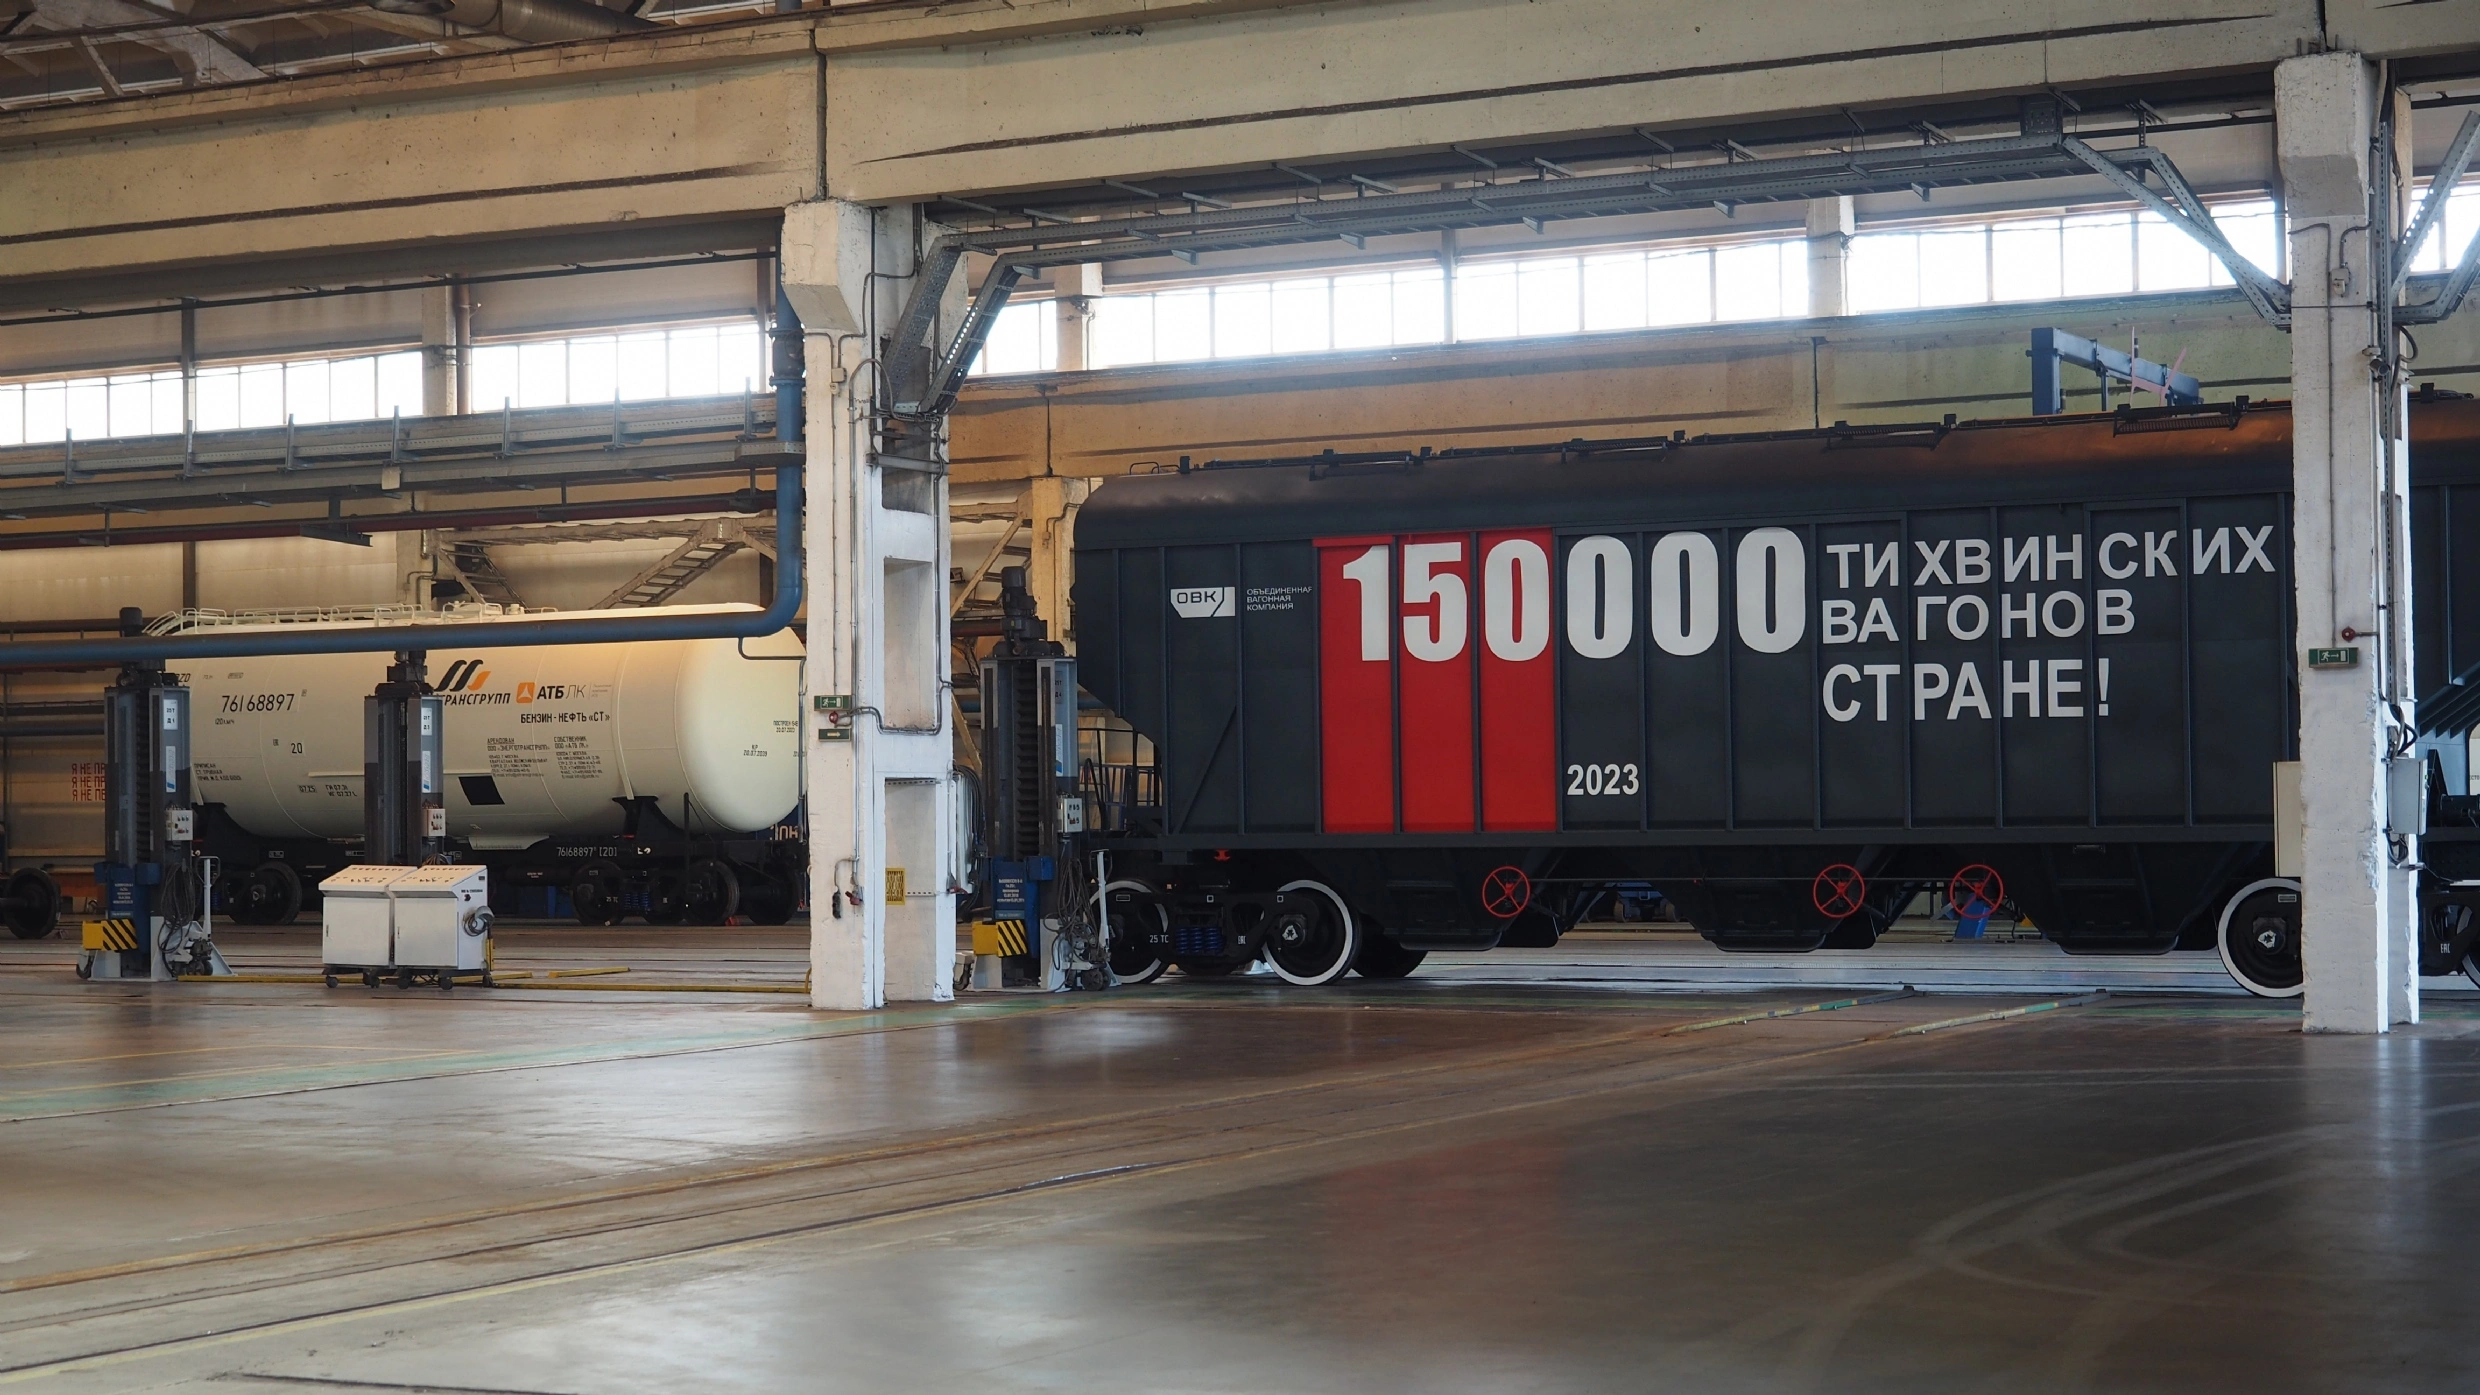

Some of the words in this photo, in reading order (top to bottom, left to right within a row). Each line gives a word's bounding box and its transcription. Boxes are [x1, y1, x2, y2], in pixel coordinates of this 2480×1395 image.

[1826, 526, 2275, 589] ТИХВИНСКИХ
[1177, 591, 1217, 604] ОВК
[1246, 595, 1291, 604] ВАГОННАЯ
[1342, 528, 1806, 662] 150000
[1246, 603, 1294, 611] КОМПАНИЯ
[1822, 589, 2135, 644] ВАГОНОВ
[536, 685, 565, 699] АТБ
[566, 684, 586, 699] ЛК
[1822, 658, 2110, 722] СТРАНЕ!
[221, 693, 295, 713] 76168897
[442, 692, 511, 706] РАНСГРУПП
[520, 712, 553, 724] БЕНЗИН
[558, 711, 587, 723] НЕФТЬ
[290, 742, 303, 754] 20
[71, 763, 77, 775] Я
[80, 763, 91, 775] НЕ
[94, 763, 105, 775] ПР
[71, 776, 77, 788] Я
[80, 776, 91, 788] НЕ
[94, 776, 105, 788] ПР
[1567, 763, 1639, 796] 2023
[72, 789, 77, 801] Я
[81, 789, 91, 801] НЕ
[95, 789, 105, 801] ПЕ
